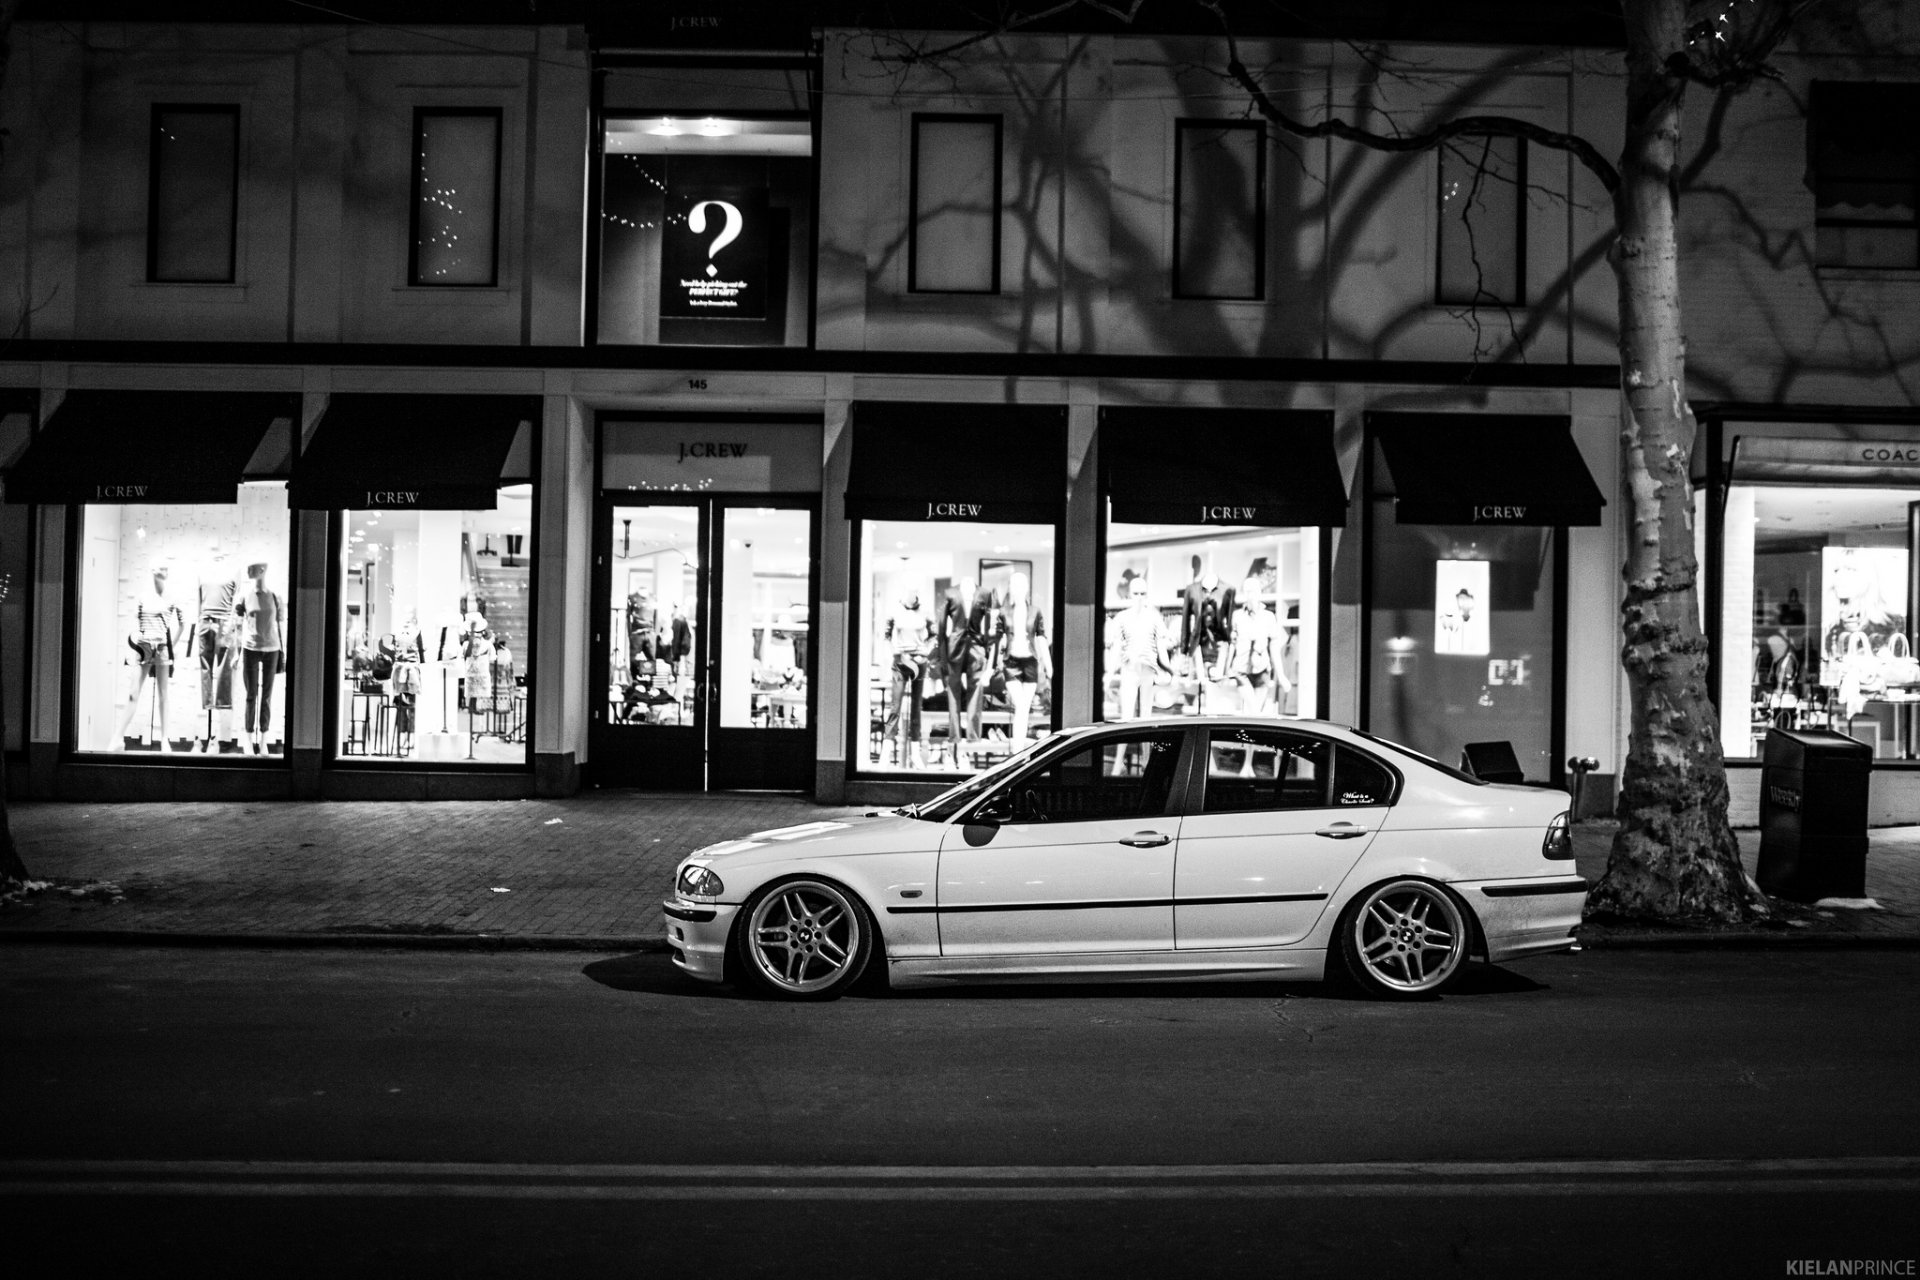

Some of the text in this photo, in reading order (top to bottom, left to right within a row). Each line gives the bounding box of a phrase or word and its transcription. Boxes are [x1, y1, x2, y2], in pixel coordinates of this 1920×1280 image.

[671, 16, 722, 31] J.CREW
[688, 379, 708, 390] 145
[677, 442, 748, 464] J.CREW
[96, 484, 149, 500] J.CREW
[366, 491, 420, 507] J.CREW
[927, 502, 982, 518] J.CREW
[1201, 506, 1257, 522] J.CREW
[1473, 505, 1527, 521] J.CREW
